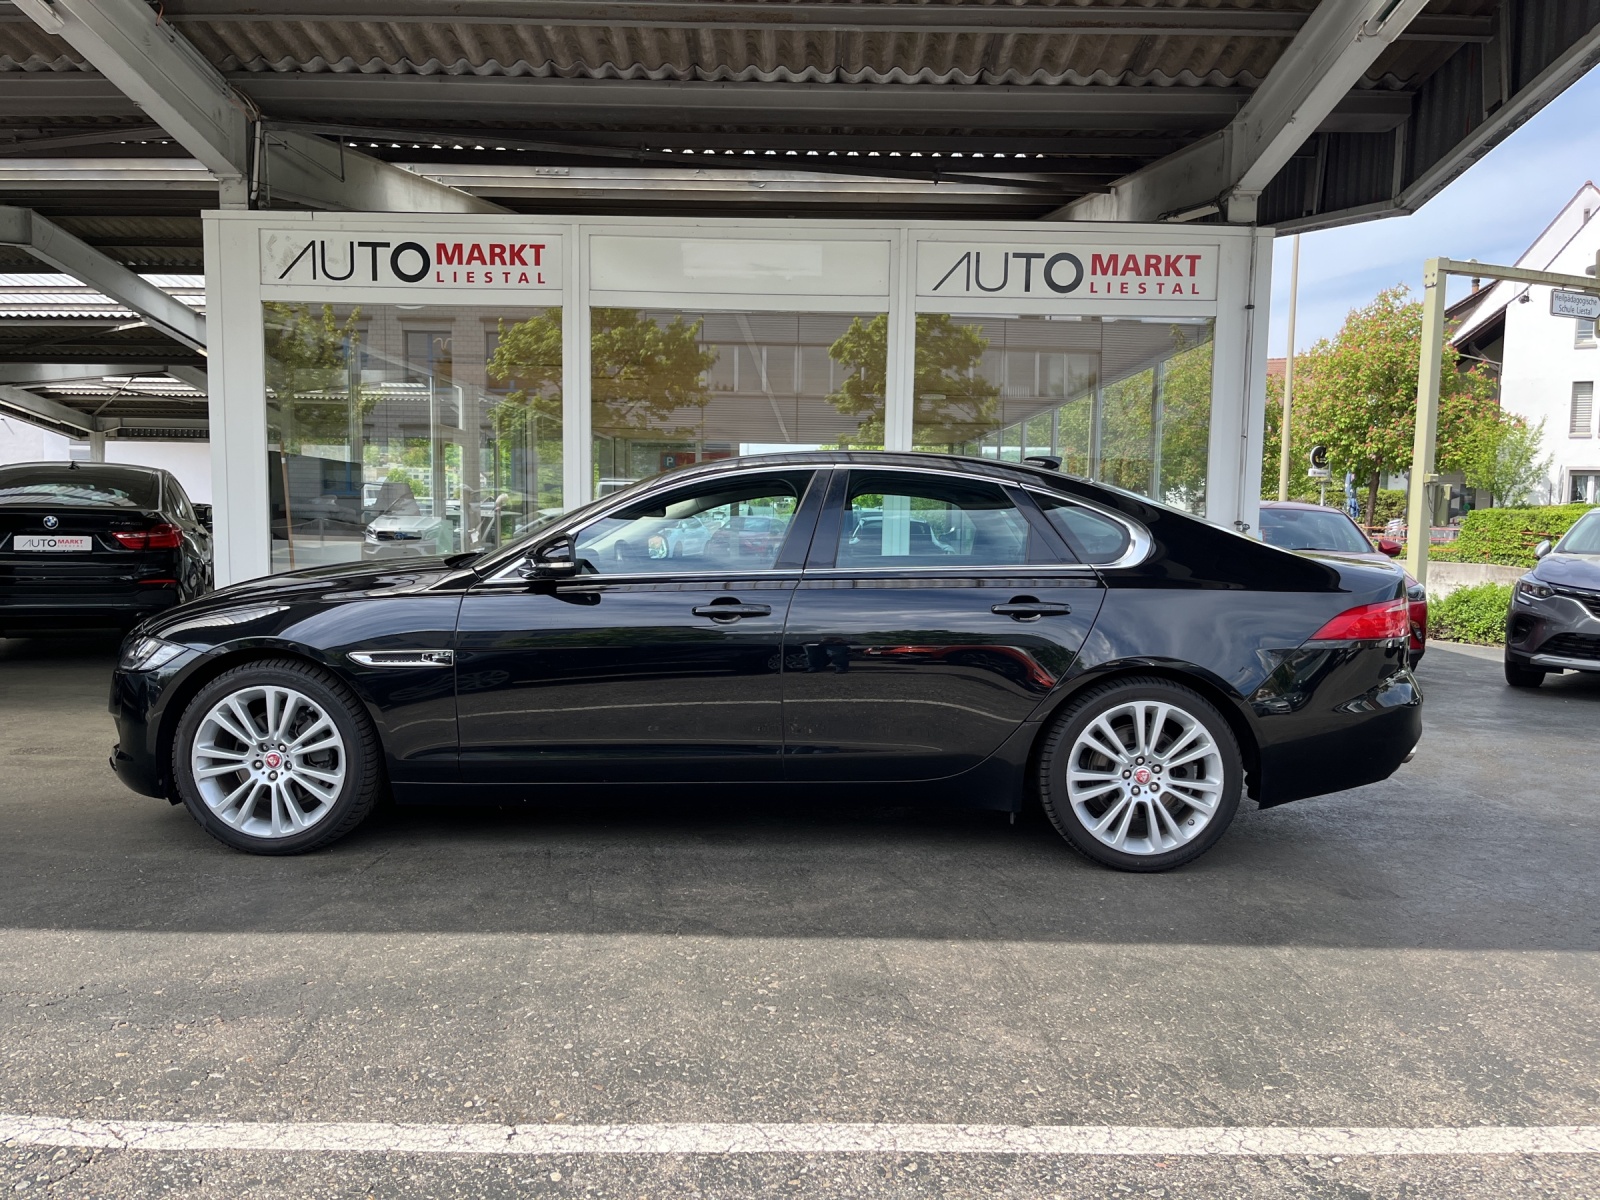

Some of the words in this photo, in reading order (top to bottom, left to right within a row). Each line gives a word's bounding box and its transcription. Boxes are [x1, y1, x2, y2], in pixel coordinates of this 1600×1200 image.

[278, 240, 431, 283] AUTO
[436, 243, 546, 266] MARKT
[436, 271, 546, 284] LIESTAL
[932, 251, 1084, 294] AUTO
[1090, 253, 1202, 277] MARKT
[1090, 281, 1200, 295] LIESTAL
[1558, 304, 1575, 313] Schule
[1576, 306, 1593, 315] Liestal
[22, 539, 57, 547] AUTO
